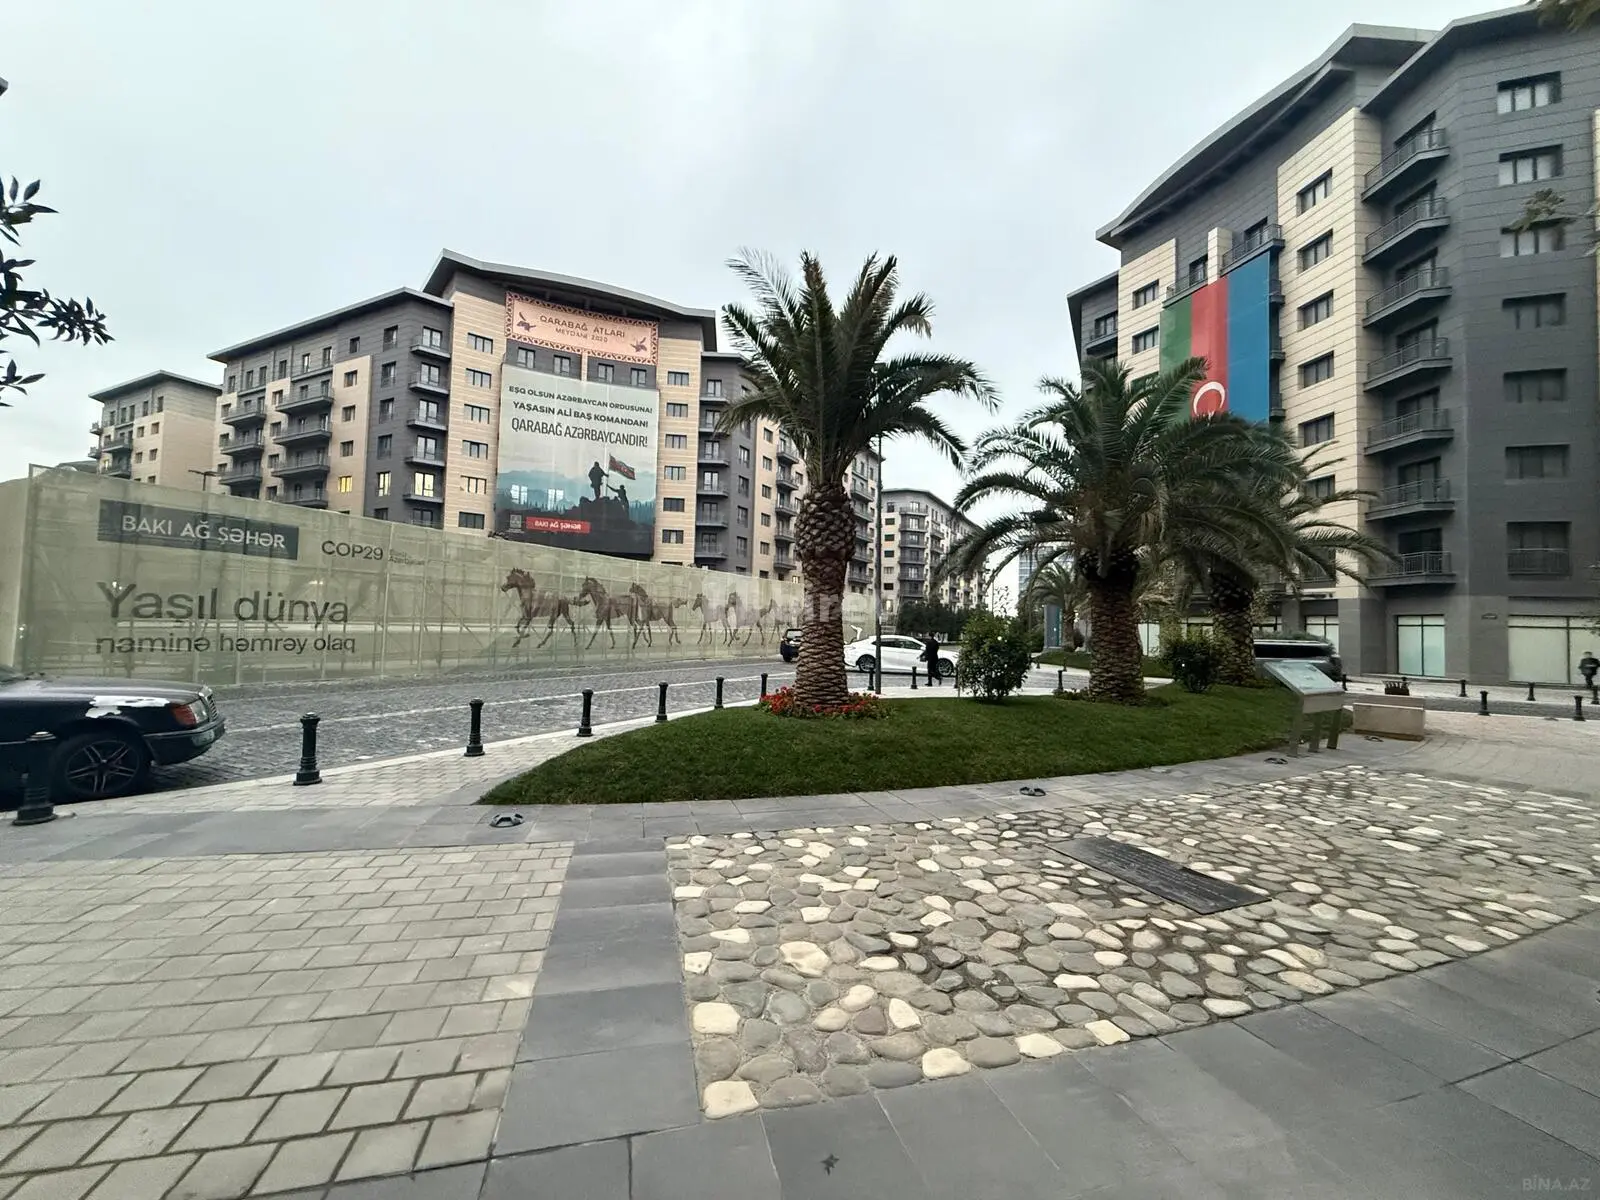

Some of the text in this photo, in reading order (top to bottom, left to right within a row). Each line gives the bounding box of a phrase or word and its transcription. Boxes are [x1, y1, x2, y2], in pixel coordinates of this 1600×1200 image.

[539, 315, 625, 338] QARABAĞ ATLARI
[508, 385, 653, 414] EŞQ OLSUN AZƏRBAYCAN ORDUSUNA!
[512, 401, 649, 428] YAŞASIN ALİ BAŞ KOMANDAN!
[511, 417, 648, 448] QARABAĞ AZƏRBAYCANDIR!
[122, 514, 286, 549] BAKI AĞ ŞƏHƏR
[321, 540, 384, 561] COP29
[96, 581, 348, 629] Yaşıl dünya
[220, 632, 307, 655] həmrəy
[313, 634, 355, 654] olaq
